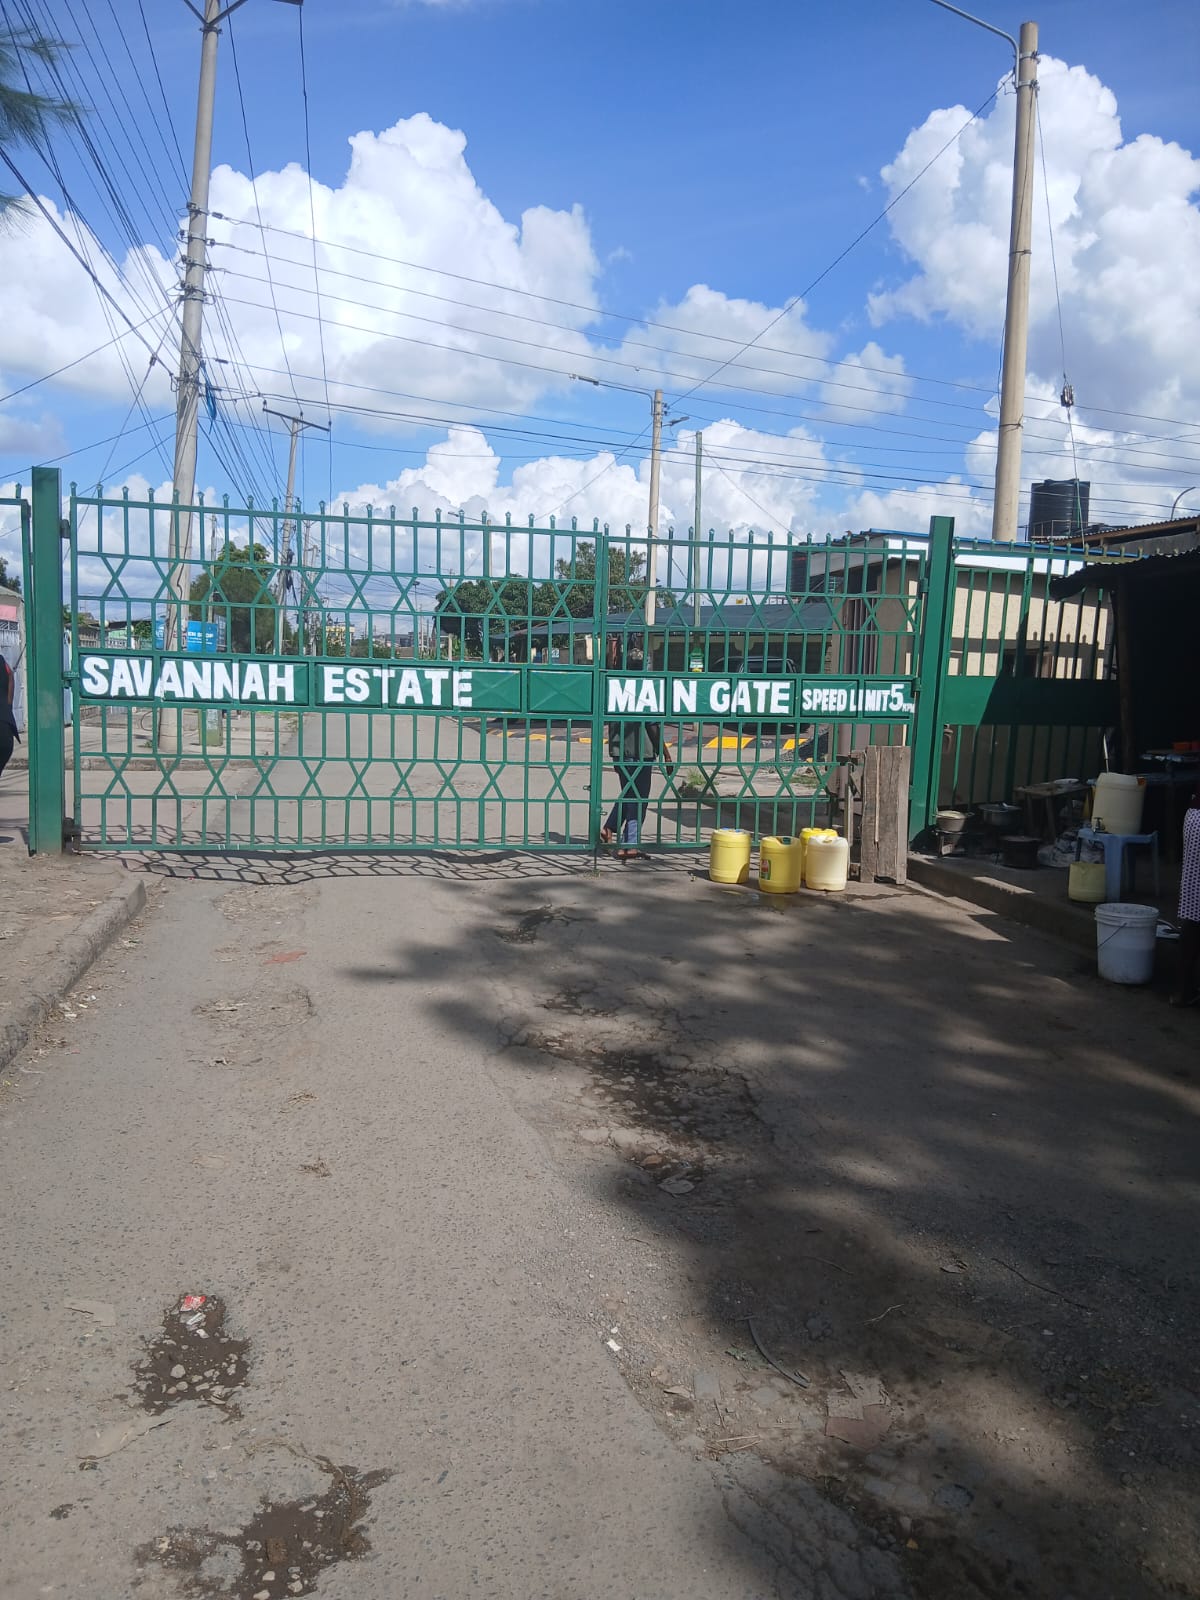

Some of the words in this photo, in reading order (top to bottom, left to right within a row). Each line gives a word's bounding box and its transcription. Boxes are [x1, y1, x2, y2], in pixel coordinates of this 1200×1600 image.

[82, 657, 295, 702] SAVANNAH
[324, 667, 472, 707] ESTATE
[608, 679, 697, 713] MAIN
[710, 681, 790, 713] GATE
[802, 689, 847, 712] SPEED
